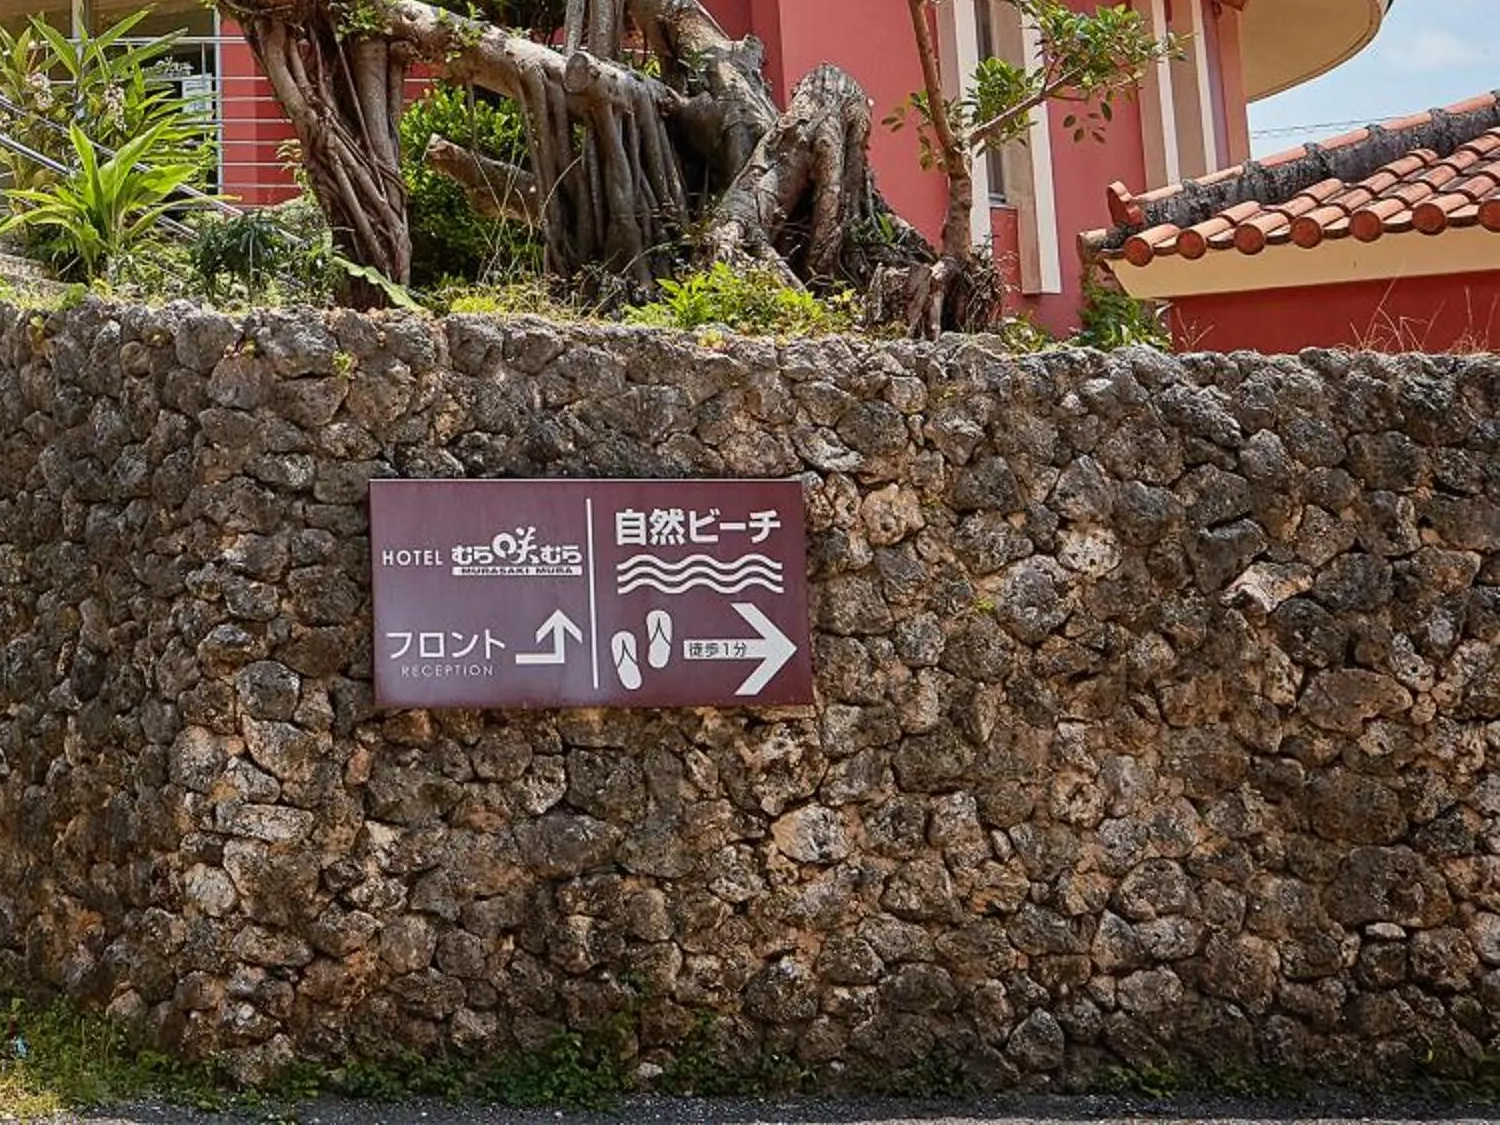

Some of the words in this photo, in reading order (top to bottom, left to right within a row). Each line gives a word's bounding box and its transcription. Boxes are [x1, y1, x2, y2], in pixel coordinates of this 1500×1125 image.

[615, 508, 781, 546] 自然ビーチ
[451, 526, 583, 565] むら咲むら
[382, 550, 443, 566] HOTEL
[386, 628, 506, 659] フロント
[688, 642, 748, 657] 徒歩1分
[401, 664, 495, 678] RECEPTION
